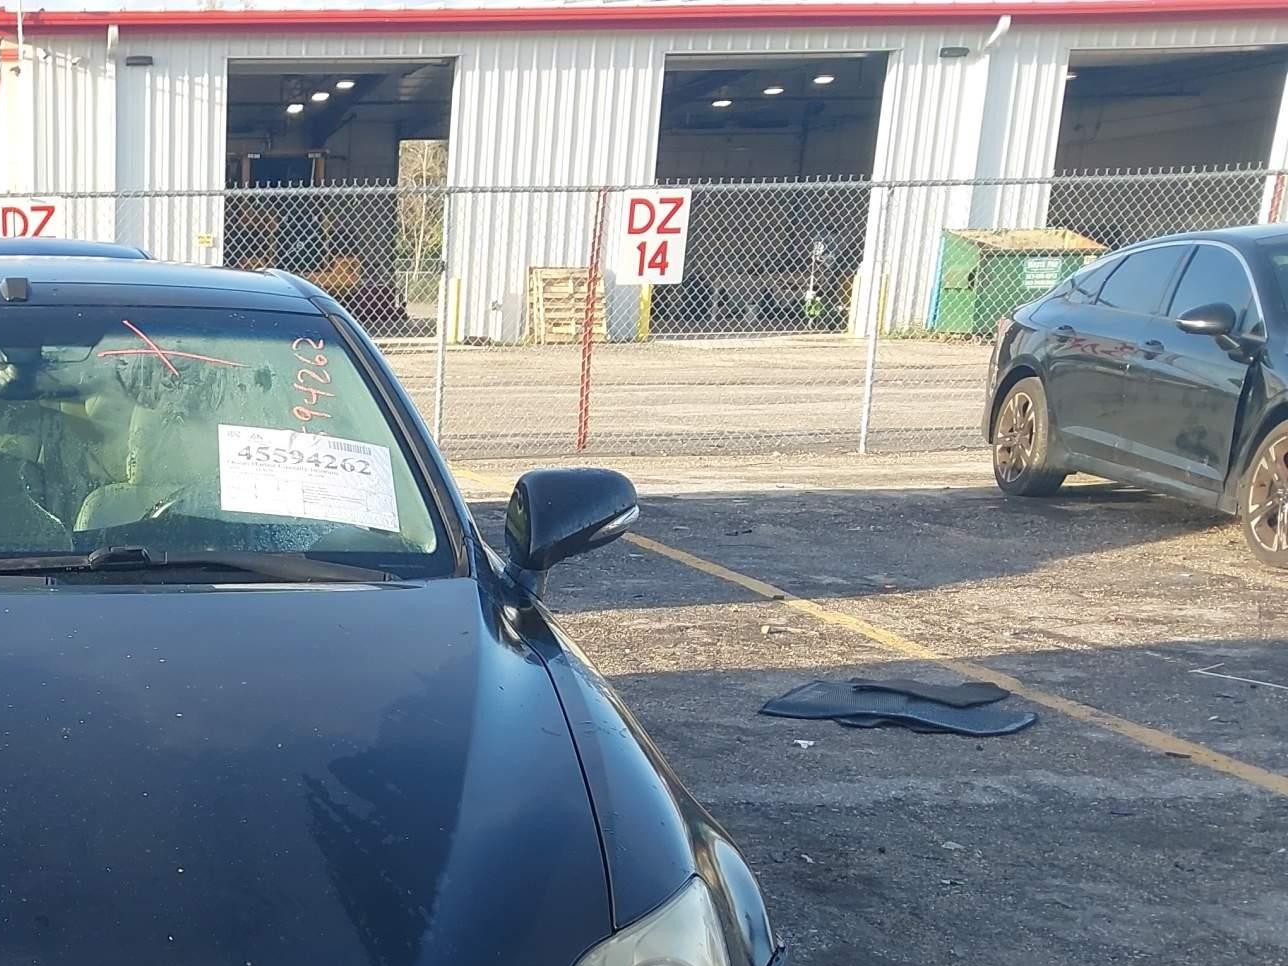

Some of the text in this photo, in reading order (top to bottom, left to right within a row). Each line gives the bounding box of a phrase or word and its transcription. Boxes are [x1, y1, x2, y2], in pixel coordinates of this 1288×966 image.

[1, 205, 56, 237] DZ
[628, 197, 684, 235] DZ
[636, 240, 669, 276] 14
[238, 445, 372, 476] 45594262
